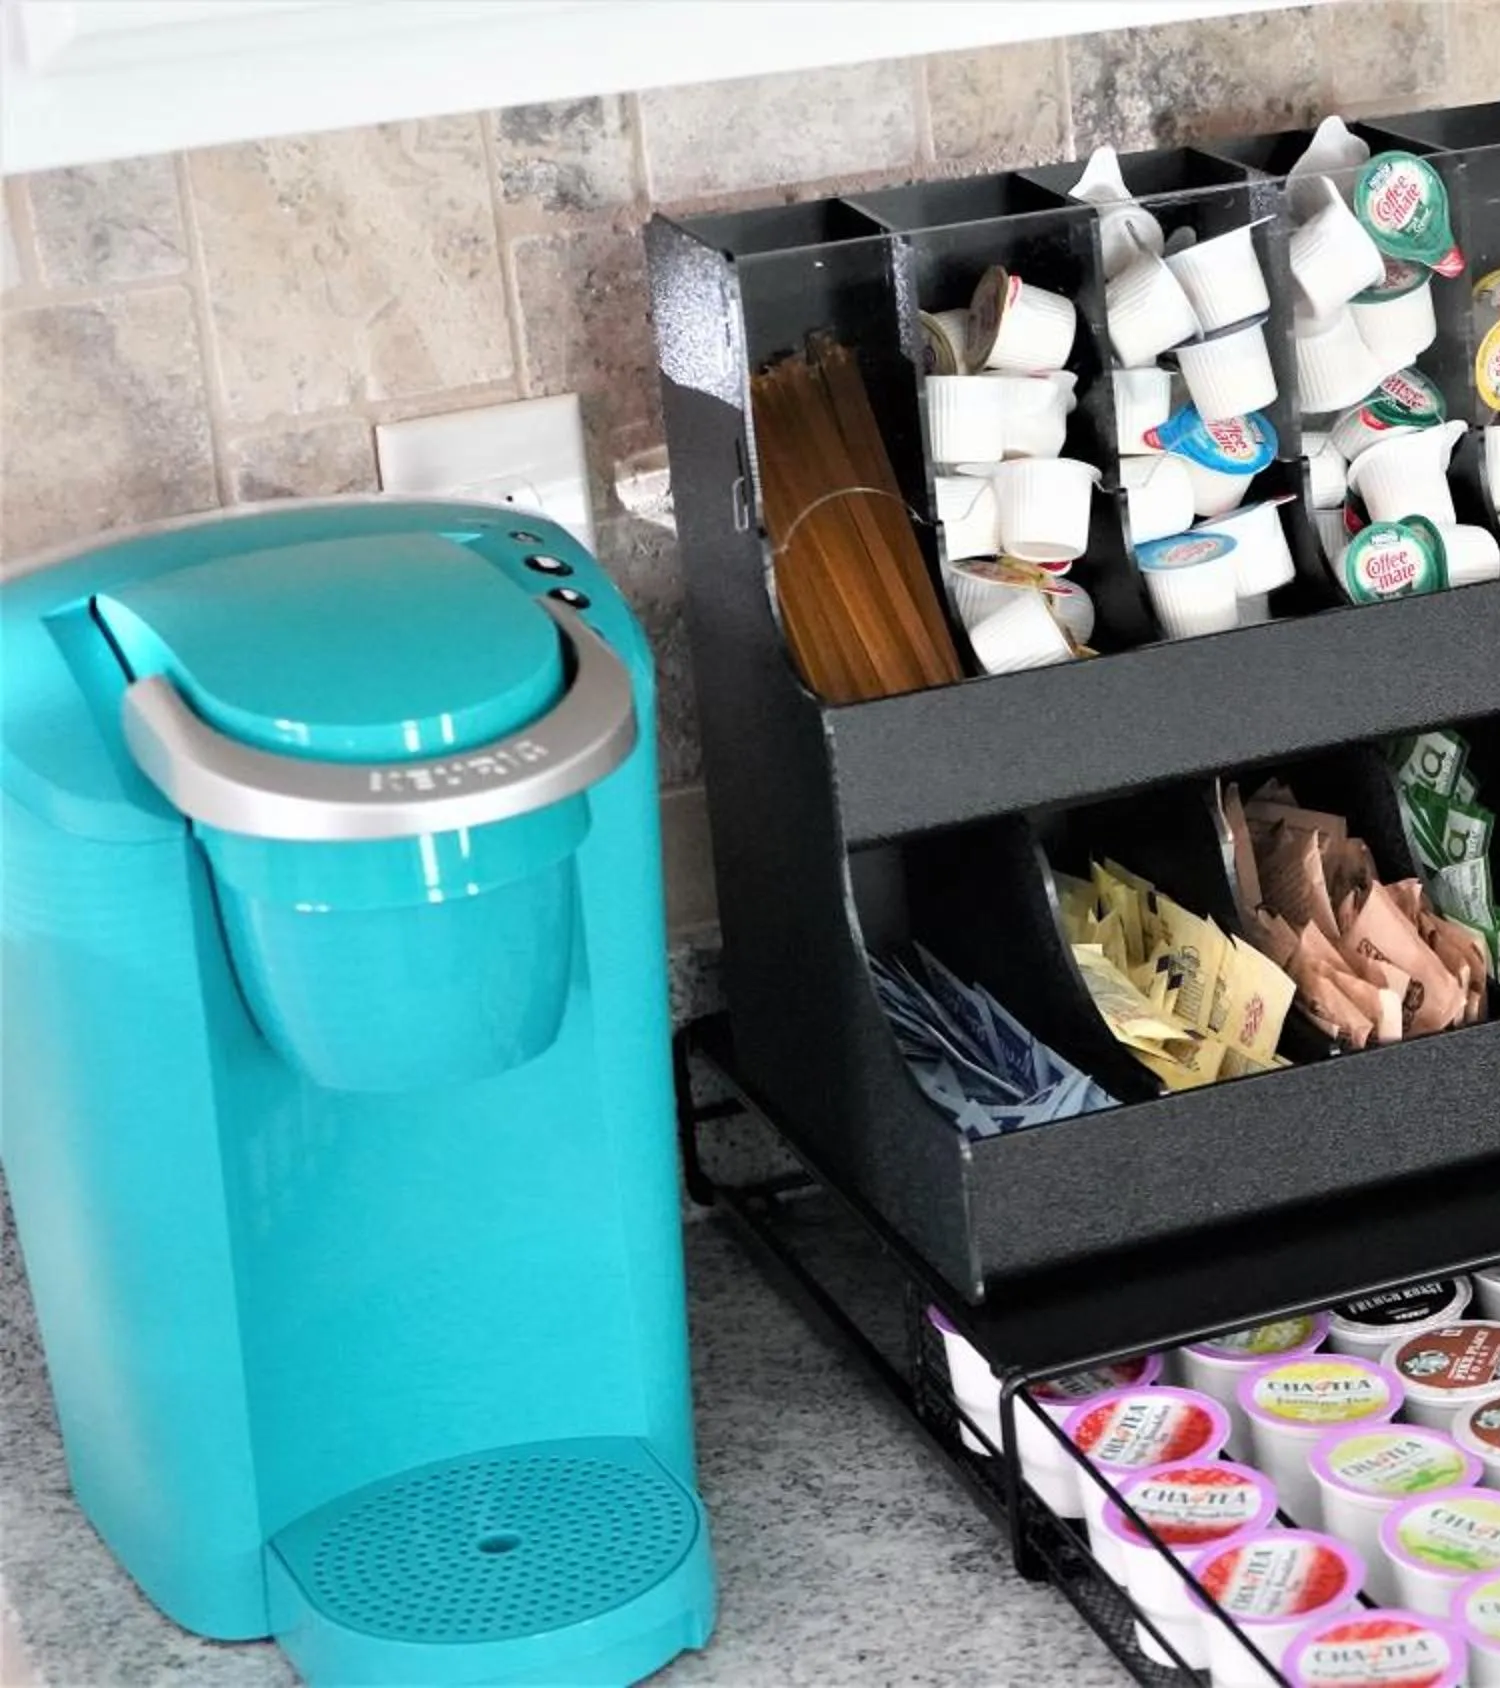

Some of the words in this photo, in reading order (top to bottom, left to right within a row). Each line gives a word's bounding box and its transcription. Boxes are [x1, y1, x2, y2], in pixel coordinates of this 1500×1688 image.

[1375, 175, 1408, 222] Coffee
[1365, 550, 1408, 579] Coffee
[1379, 562, 1416, 590] mate
